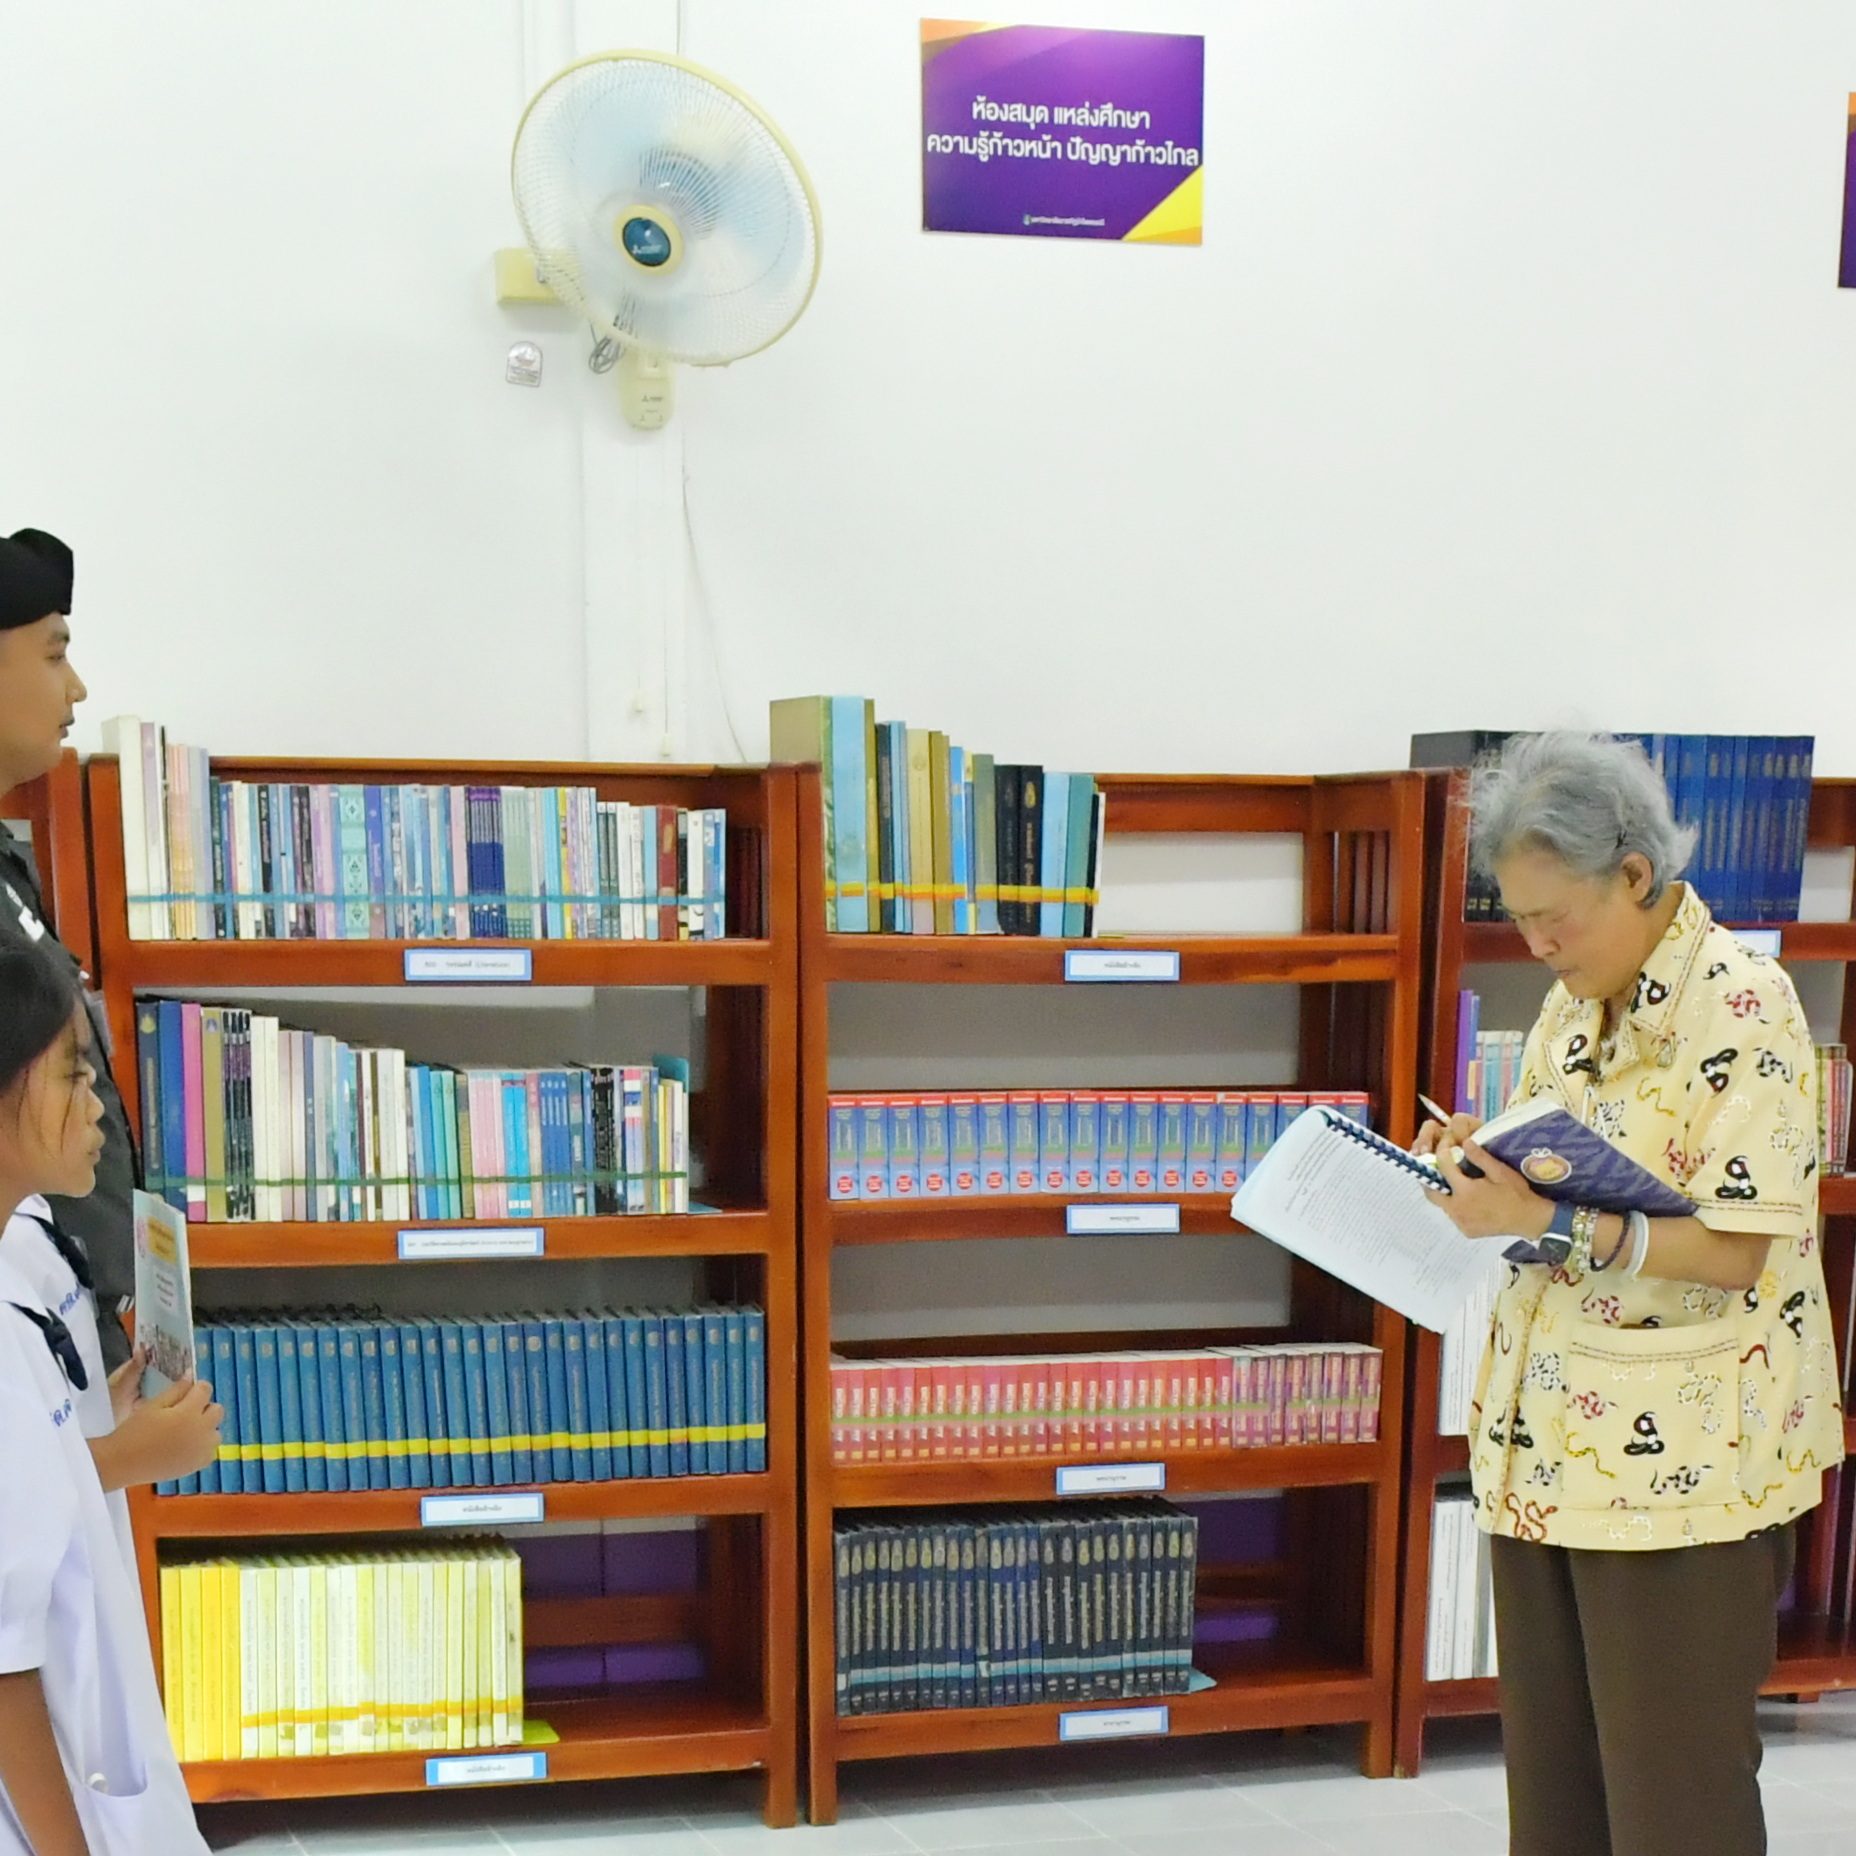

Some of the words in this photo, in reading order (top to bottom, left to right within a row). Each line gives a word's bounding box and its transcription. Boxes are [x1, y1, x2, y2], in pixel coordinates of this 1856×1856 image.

[972, 95, 1048, 130] ห้องสมุด
[1053, 101, 1150, 130] แหล่งศึกษา
[926, 130, 1062, 162] ความรู้ก้าวหน้า
[1067, 136, 1199, 166] ปัญญาก้าวไกล
